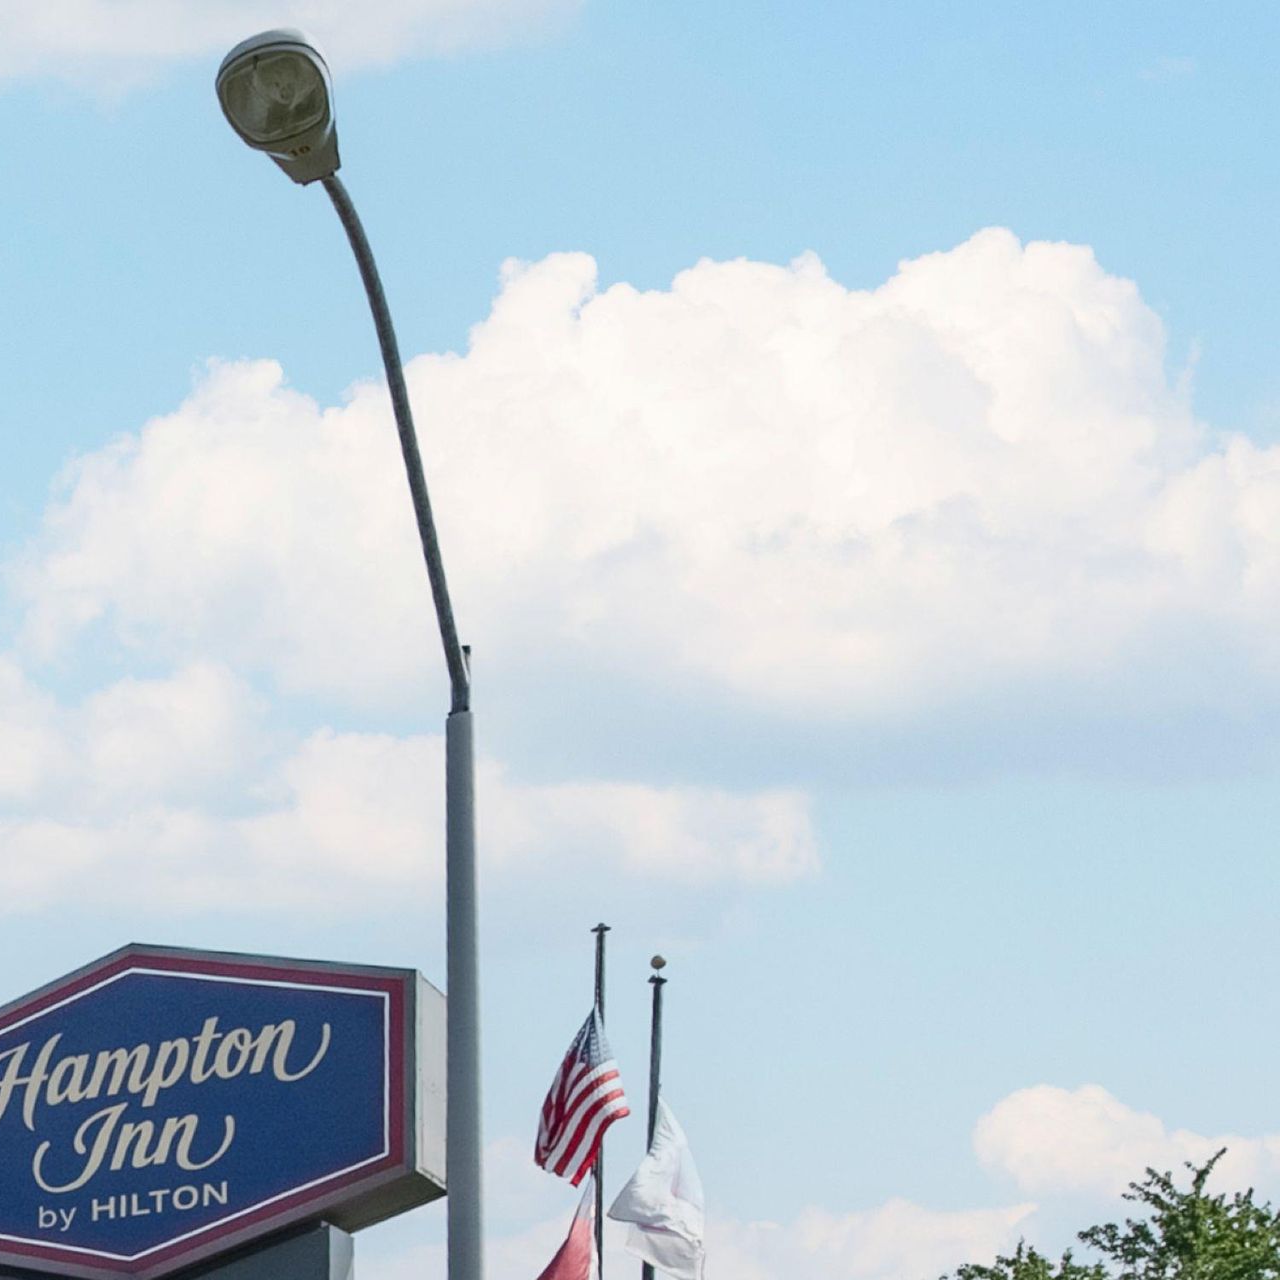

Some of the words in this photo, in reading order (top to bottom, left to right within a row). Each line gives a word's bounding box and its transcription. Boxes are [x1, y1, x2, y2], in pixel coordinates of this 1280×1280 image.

[32, 1102, 235, 1193] Inn
[39, 1206, 77, 1232] by
[91, 1181, 229, 1221] HILTON
